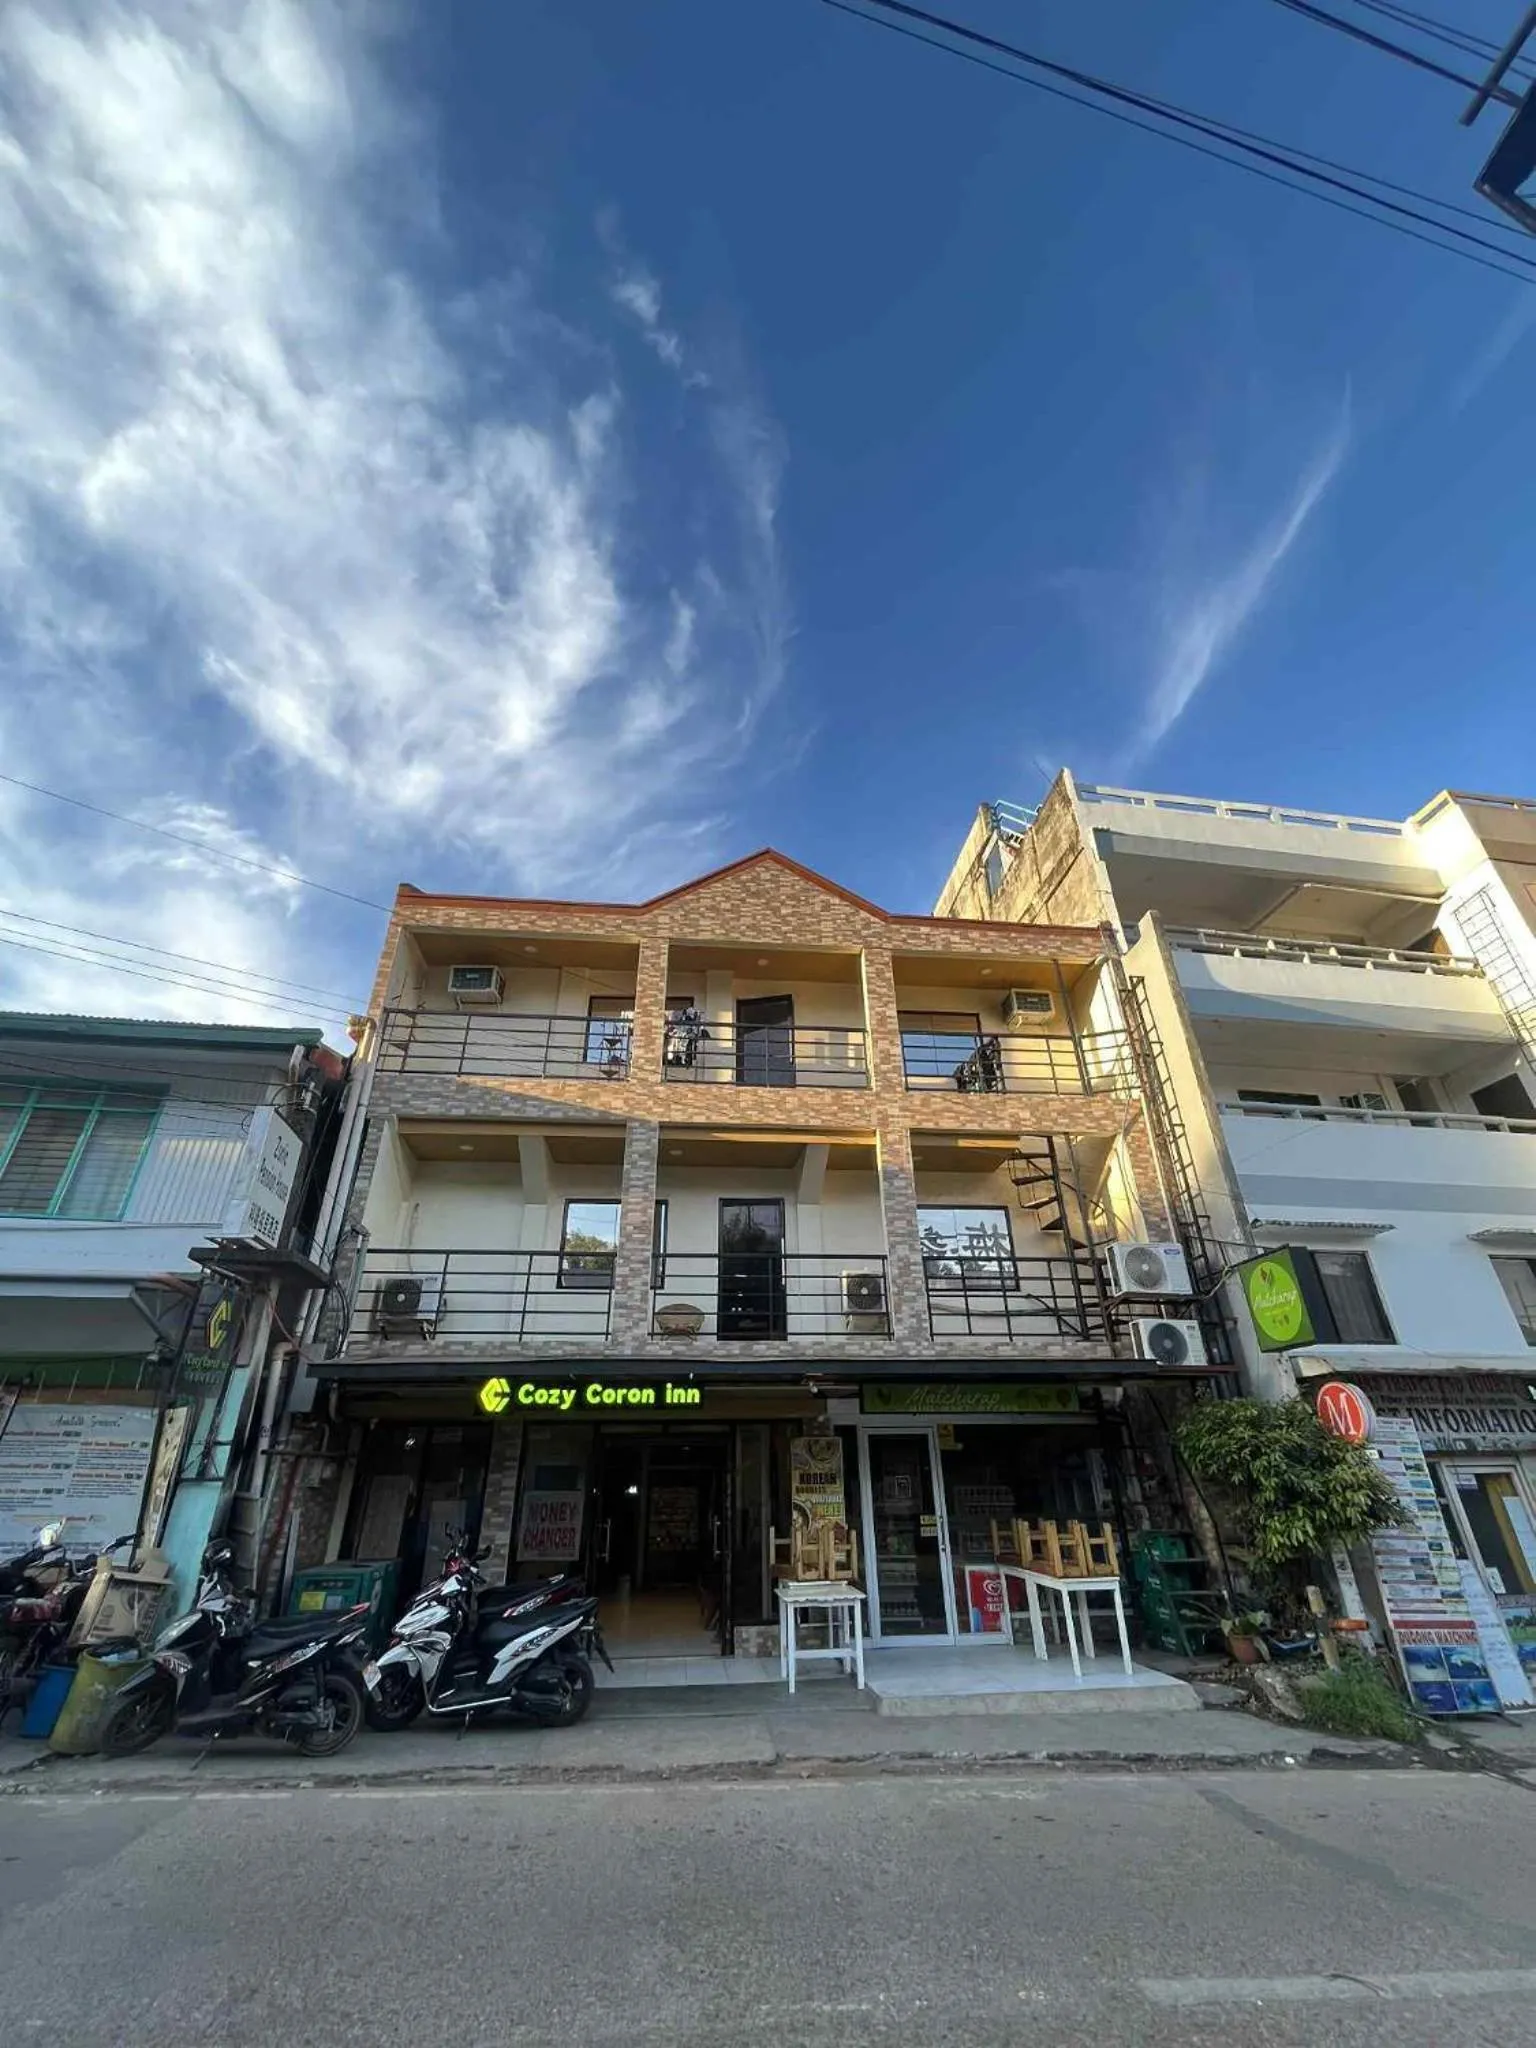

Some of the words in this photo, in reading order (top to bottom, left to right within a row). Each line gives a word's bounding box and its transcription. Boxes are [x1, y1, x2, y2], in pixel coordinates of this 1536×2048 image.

[518, 1383, 576, 1410] Cozy
[586, 1383, 655, 1404] Coron
[665, 1382, 700, 1403] inn
[1323, 1392, 1358, 1436] M
[799, 1471, 837, 1485] KOREAN
[529, 1501, 577, 1524] MONEY
[523, 1526, 577, 1550] CHANGER
